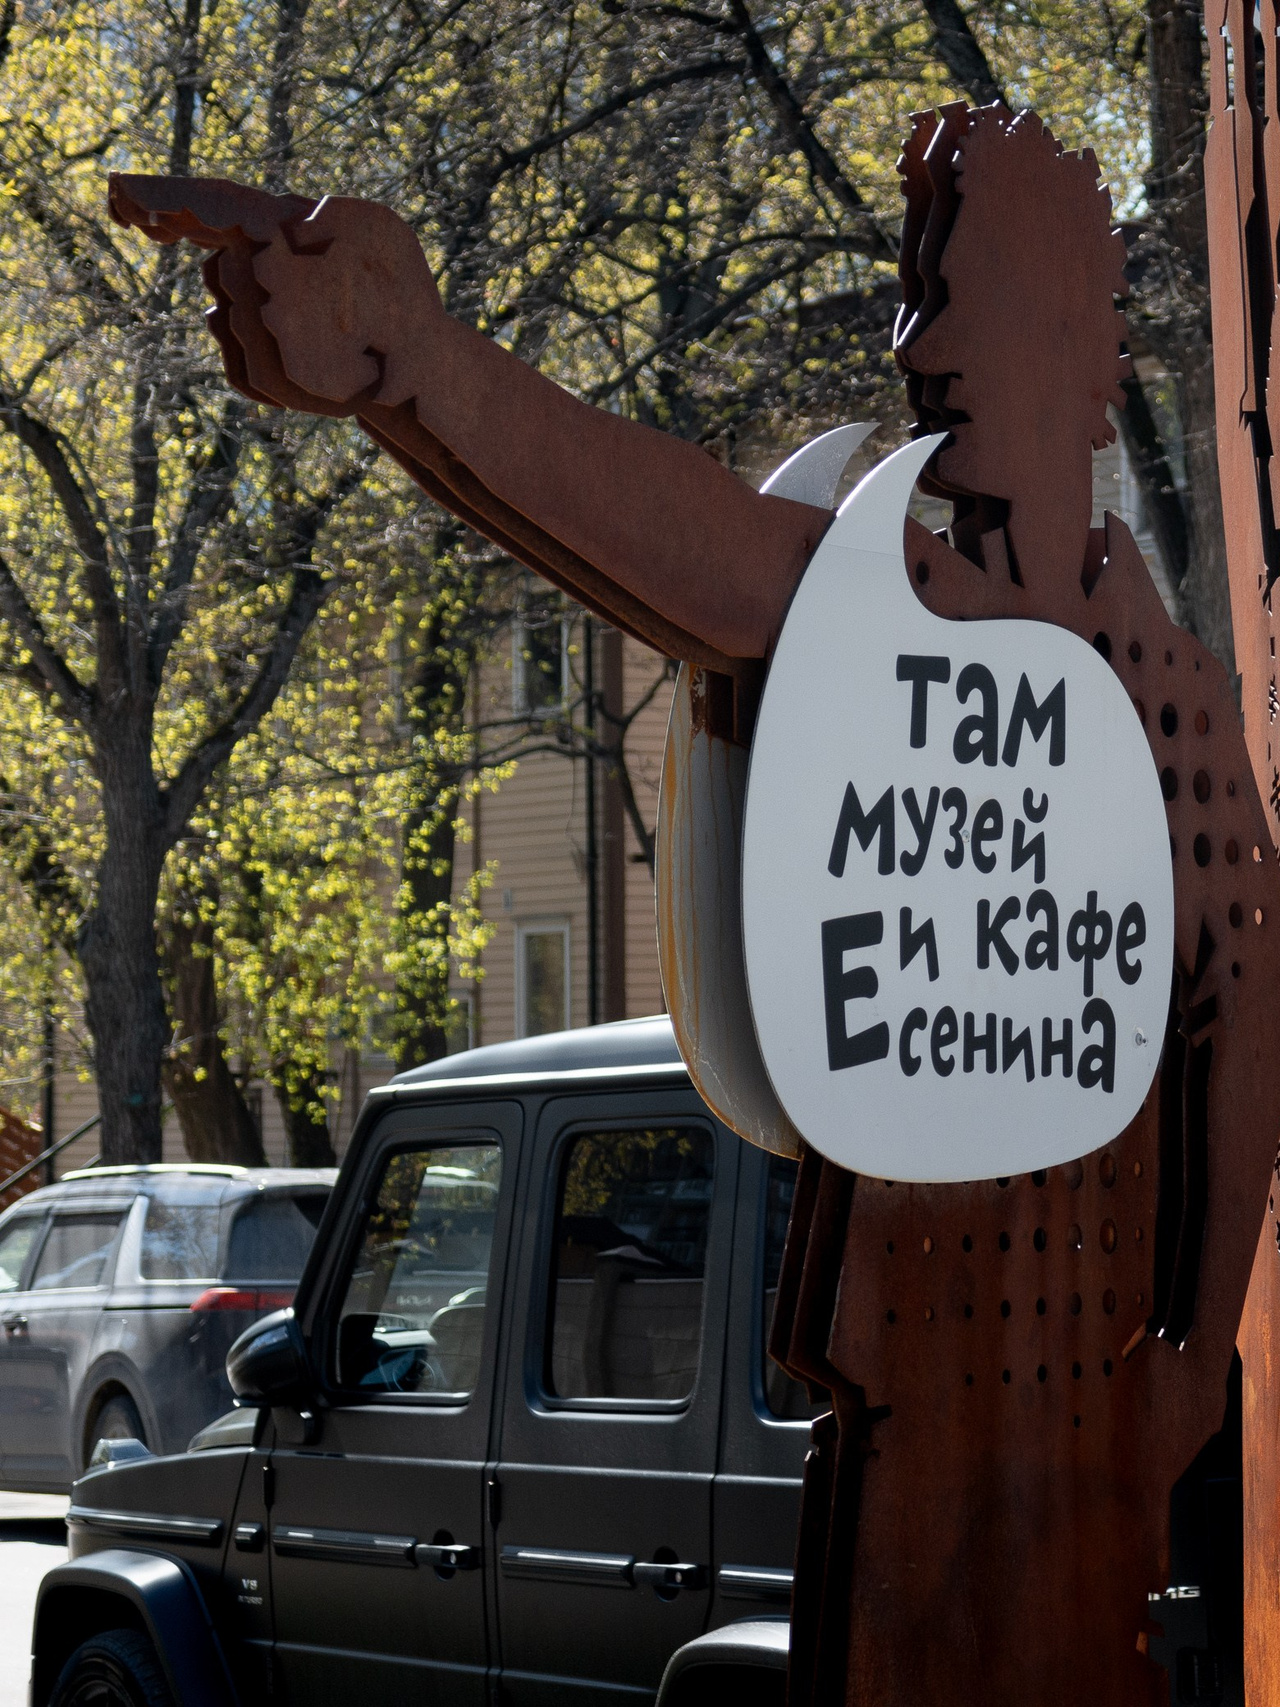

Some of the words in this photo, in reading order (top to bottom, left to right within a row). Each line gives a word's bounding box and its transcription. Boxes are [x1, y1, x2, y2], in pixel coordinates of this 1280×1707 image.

[821, 910, 1117, 1094] Есенина
[899, 906, 940, 982] и
[976, 888, 1147, 998] кафе
